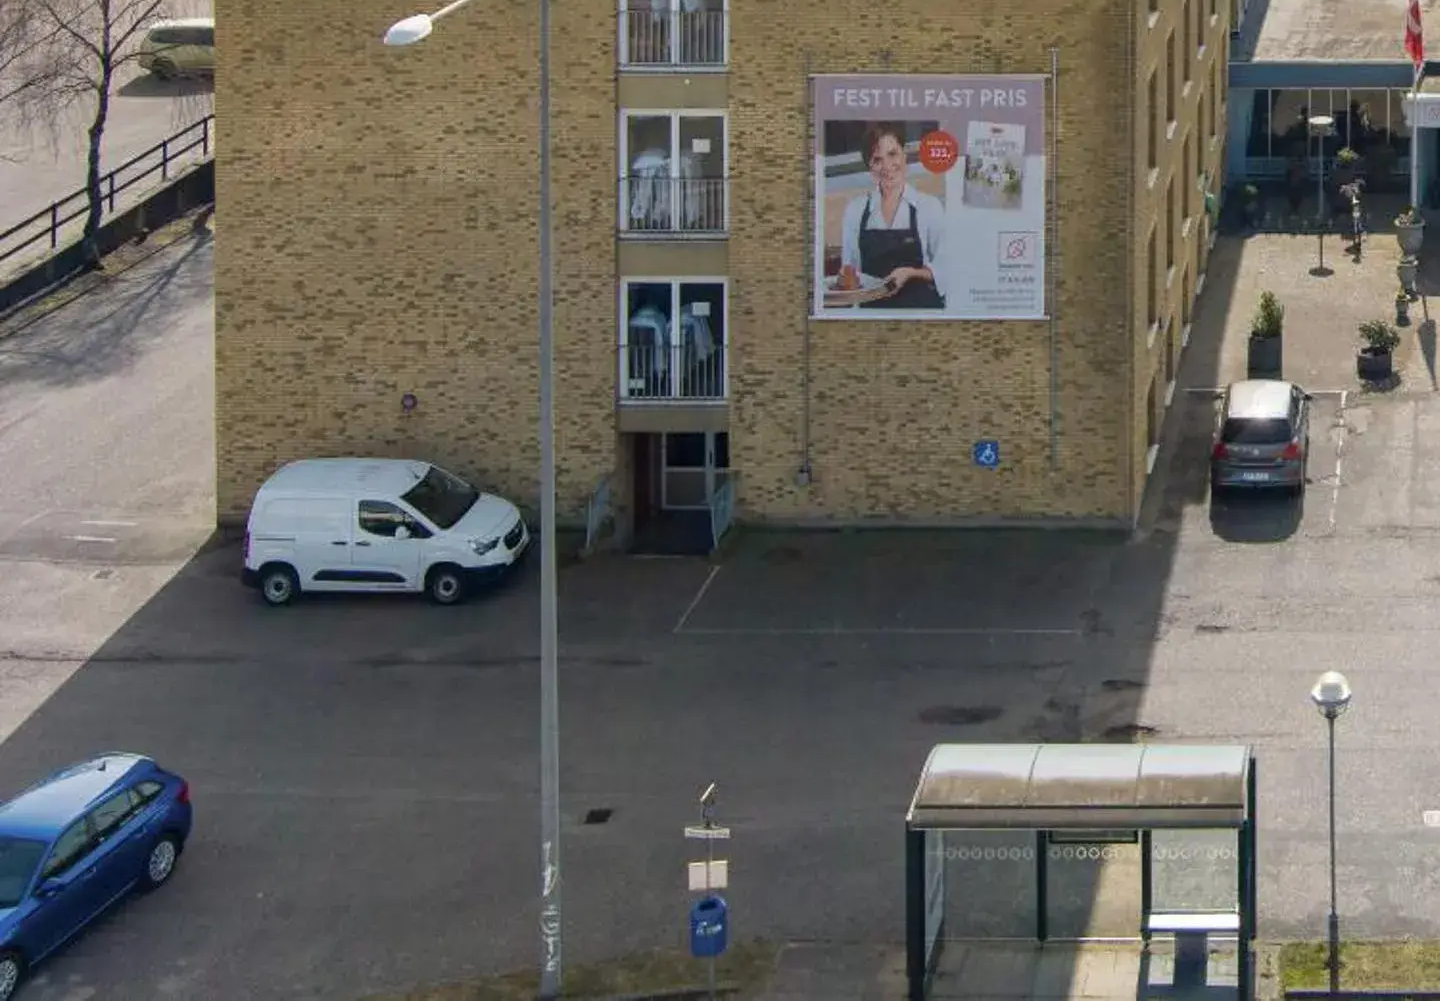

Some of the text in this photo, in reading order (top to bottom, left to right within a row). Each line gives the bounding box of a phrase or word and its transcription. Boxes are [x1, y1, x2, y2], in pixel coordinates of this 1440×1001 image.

[834, 89, 1027, 107] FEST TIL FAST PRIS
